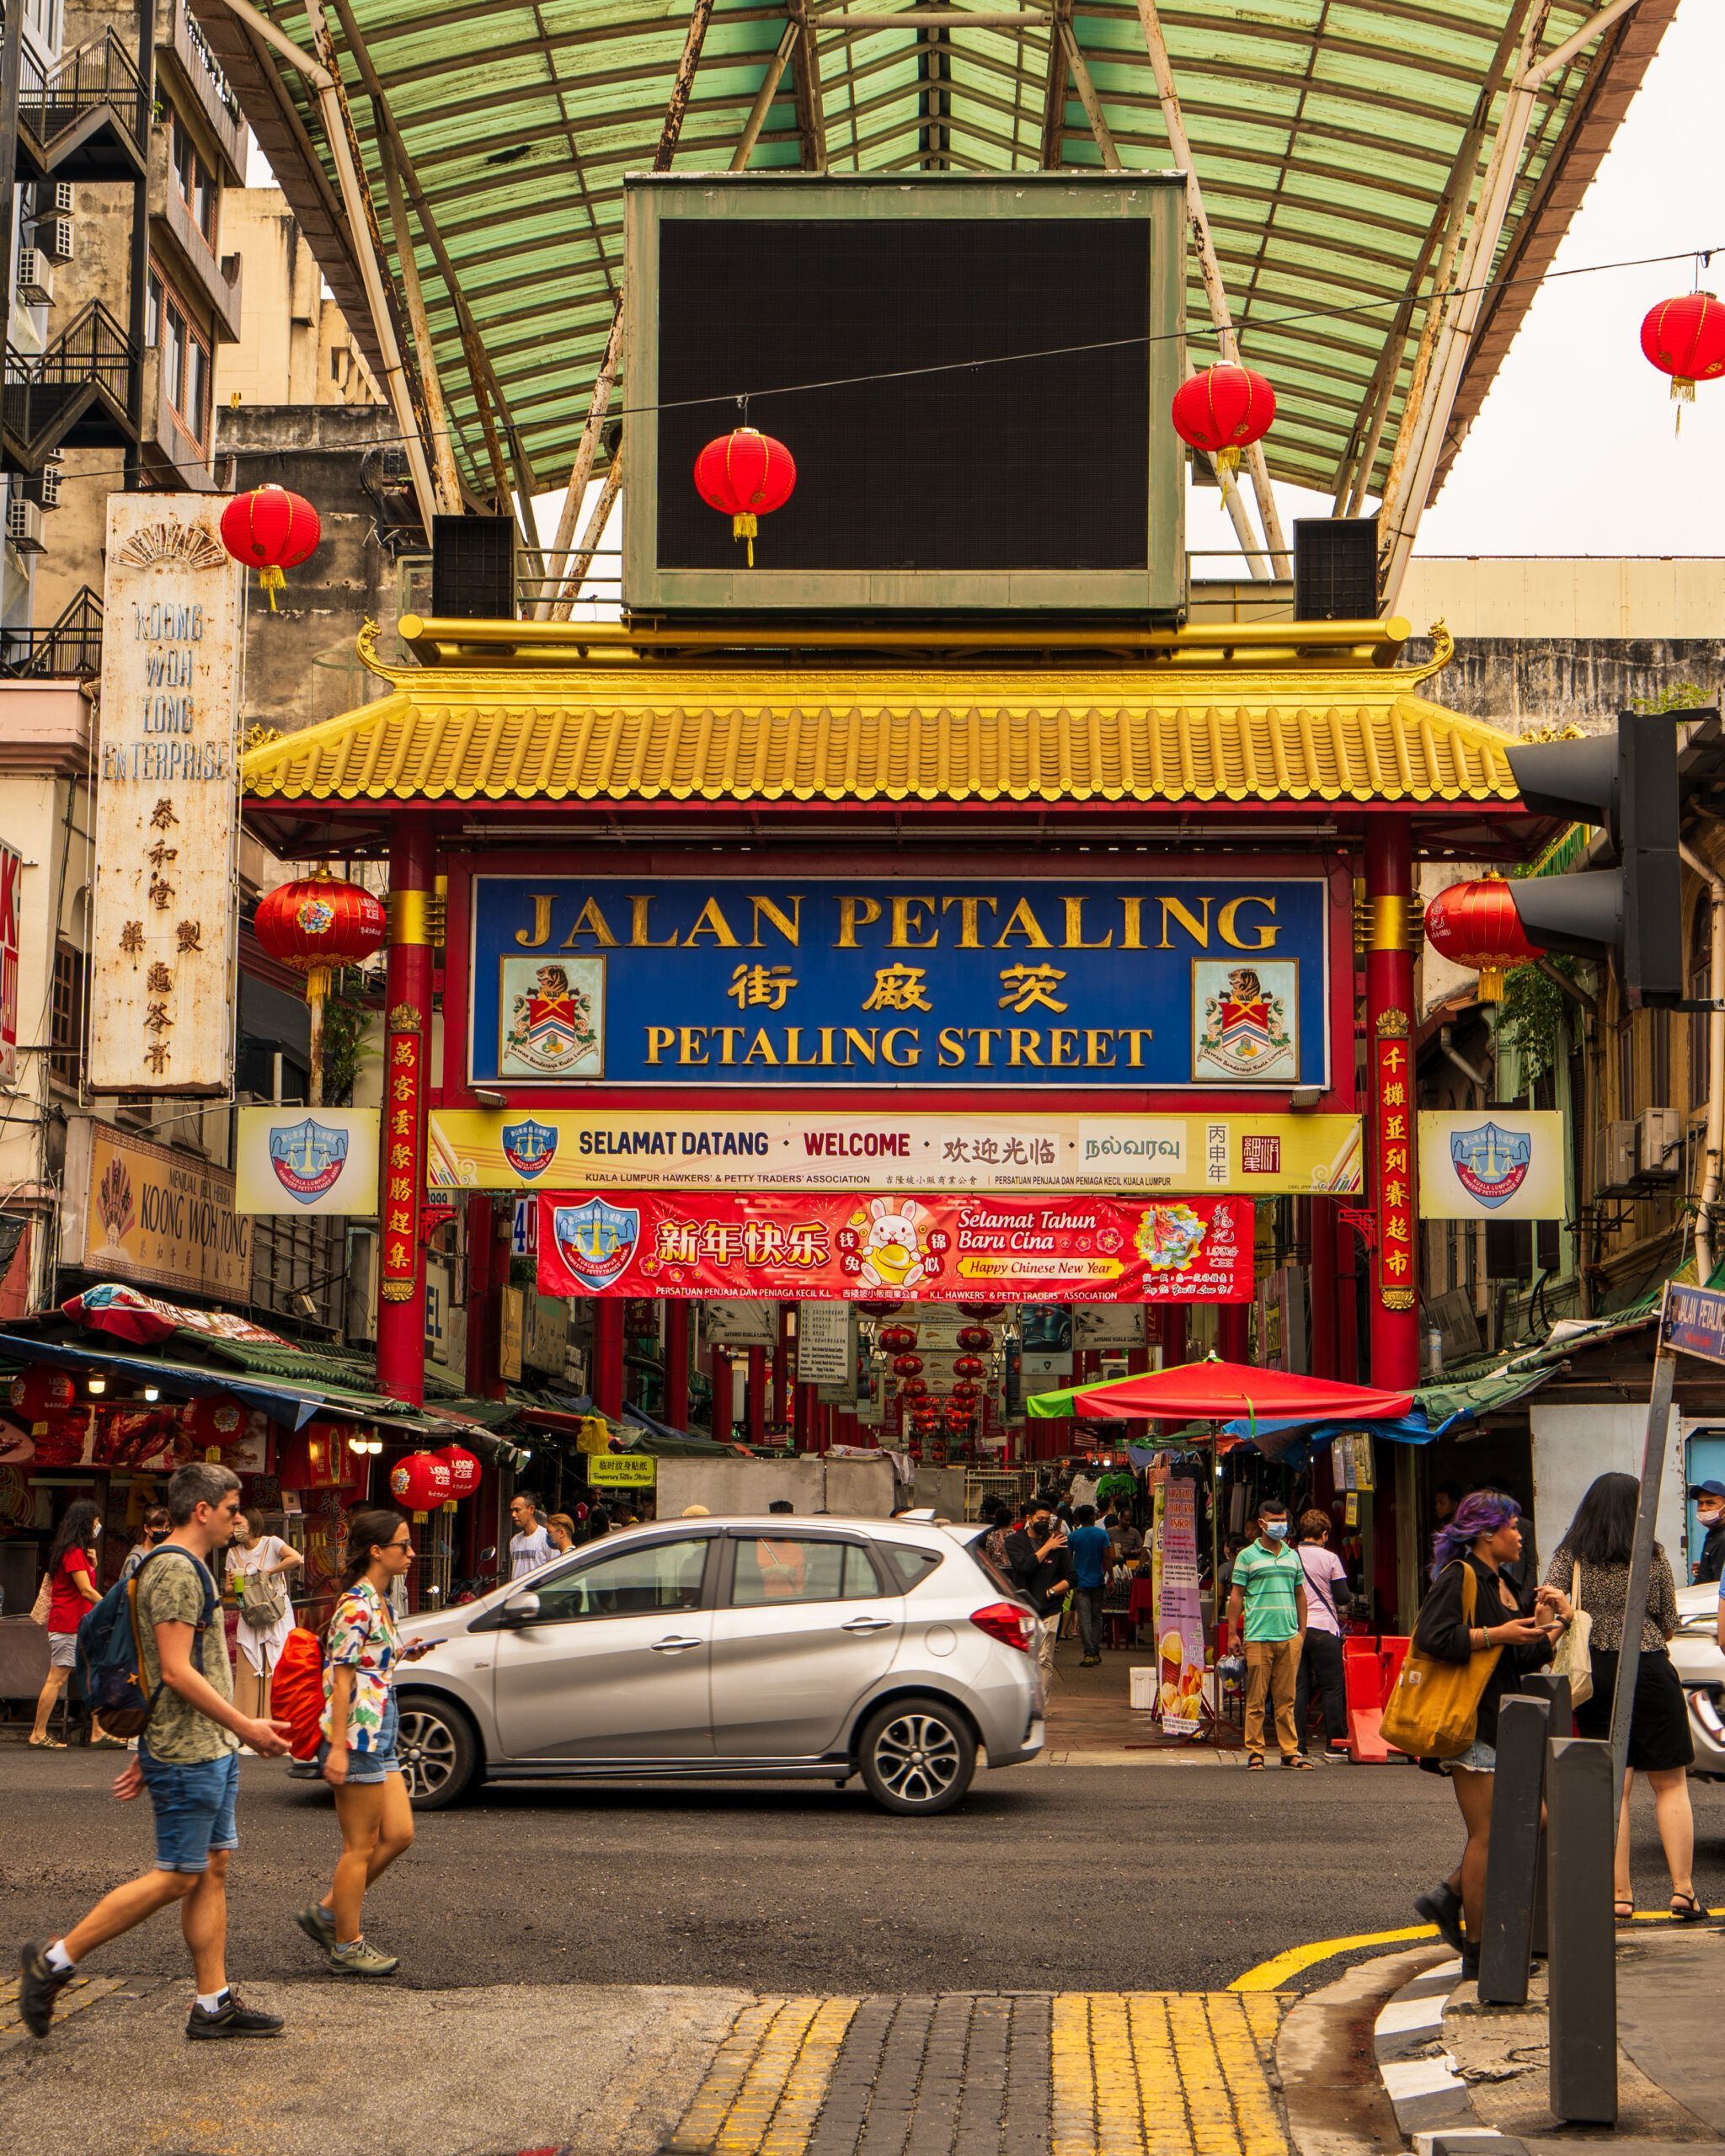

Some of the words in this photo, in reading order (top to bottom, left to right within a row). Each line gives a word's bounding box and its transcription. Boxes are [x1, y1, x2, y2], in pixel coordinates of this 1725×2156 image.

[132, 601, 203, 641] KOONG
[145, 646, 193, 687] WOH
[103, 741, 229, 781] ENTERPRISE
[515, 894, 807, 948] JALAN
[831, 895, 1282, 950] PETALING
[644, 1027, 922, 1068] PETALING
[938, 1027, 1152, 1068] STREET
[579, 1131, 677, 1155] SELAMAT
[682, 1131, 769, 1155] DATANG
[804, 1133, 911, 1156] WELCOME
[942, 1136, 1055, 1166] 欢迎光临
[1209, 1125, 1226, 1182] 丙申年
[585, 1173, 618, 1182] KUALA
[621, 1173, 660, 1182] LUMPUR
[724, 1174, 756, 1183] PETTY
[806, 1175, 870, 1183] ASSOCIATION
[995, 1176, 1030, 1185] PERSATUAN
[1033, 1177, 1060, 1185] PENJAJA
[1061, 1177, 1074, 1186] DAN
[1076, 1177, 1103, 1186] PENIAGA
[1103, 1177, 1122, 1186] KECIL
[1123, 1177, 1144, 1186] KUALA
[1146, 1177, 1171, 1186] LUMPUR
[141, 1183, 184, 1240] KOONG
[190, 1198, 217, 1248] WOH
[222, 1210, 248, 1258] TONG
[959, 1209, 1035, 1228] Selamat
[1041, 1211, 1097, 1229] Tahun
[656, 1219, 830, 1267] 新年快乐
[959, 1230, 1006, 1249] Baru
[1011, 1231, 1054, 1250] Cina
[970, 1261, 1008, 1275] Happy
[1012, 1262, 1055, 1273] Chinese
[1059, 1263, 1087, 1273] New
[1087, 1262, 1112, 1273] Year
[656, 1287, 702, 1295] PERSATUAN
[704, 1287, 739, 1296] PENJAJA
[740, 1288, 757, 1296] DAN
[759, 1288, 793, 1297] PENIAGA
[796, 1289, 817, 1297] KECIL
[820, 1289, 833, 1298] K.L.
[1678, 1294, 1698, 1325] JALAN
[1698, 1299, 1725, 1332] PETALIN
